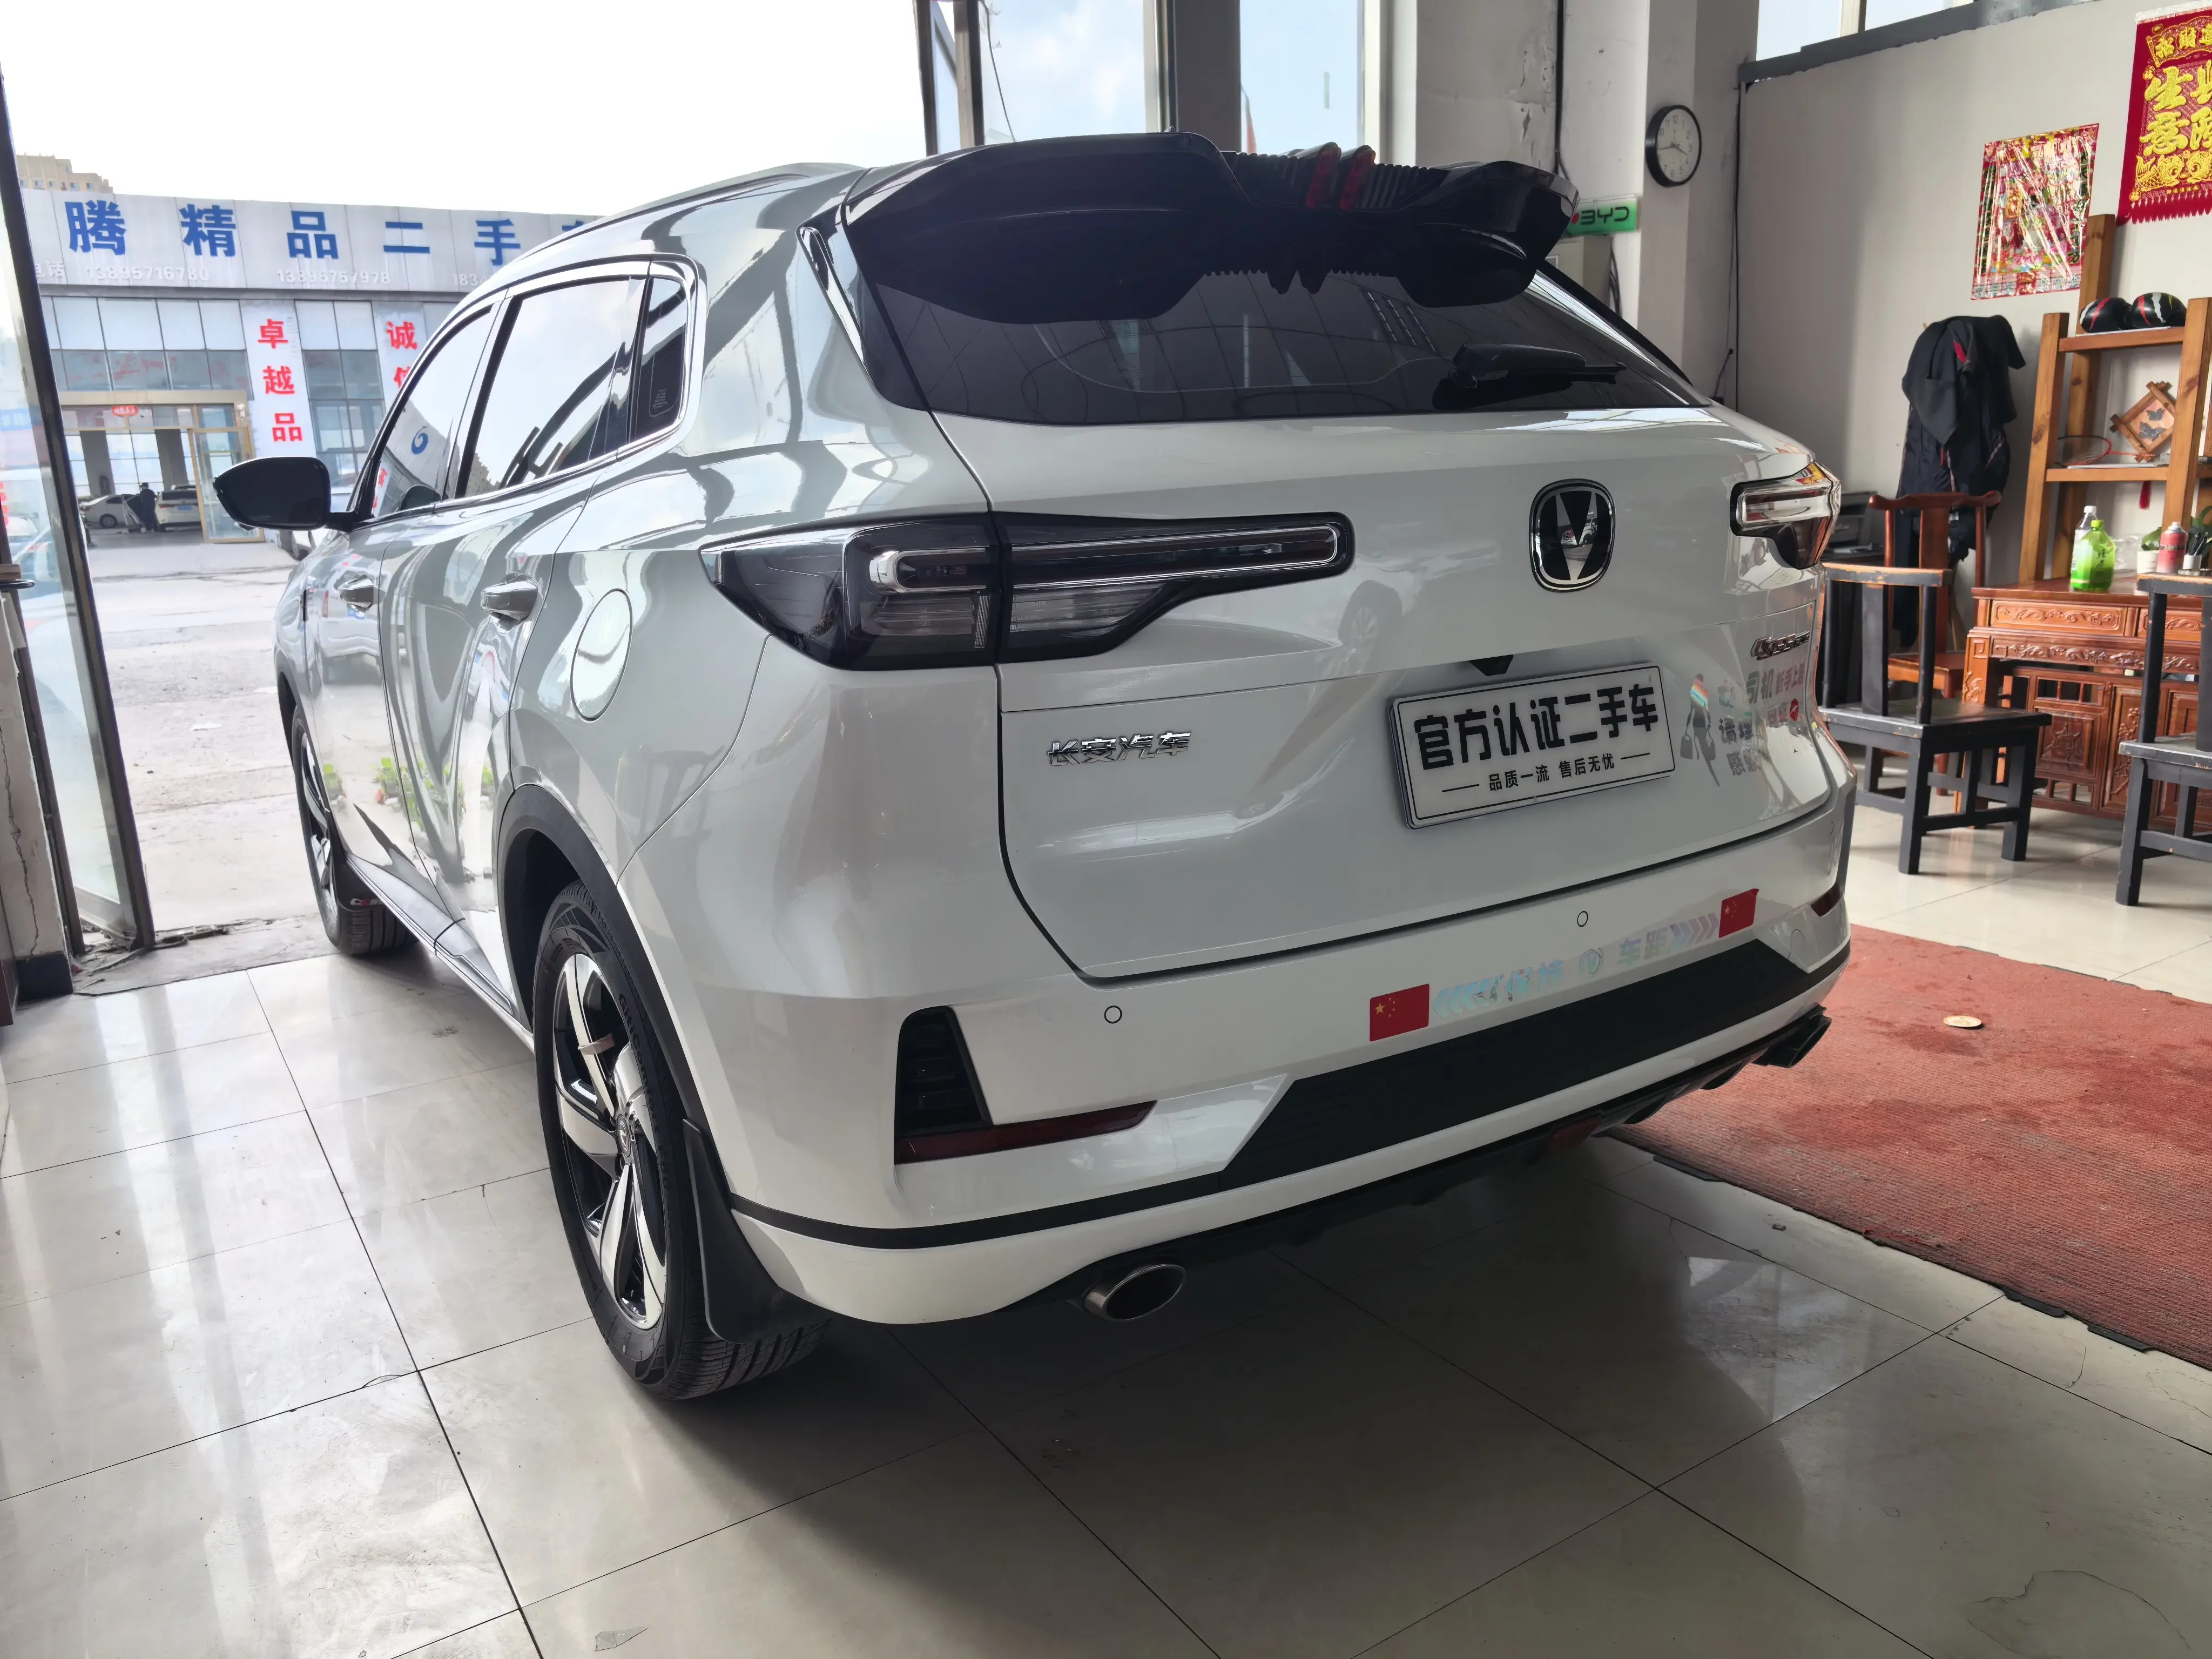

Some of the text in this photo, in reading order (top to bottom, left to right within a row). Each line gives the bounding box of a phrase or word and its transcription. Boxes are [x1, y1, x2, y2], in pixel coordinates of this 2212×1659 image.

[1580, 206, 1630, 225] BYD
[1414, 684, 1658, 770] 官方认证二手车
[1047, 731, 1192, 767] 长安汽车
[1488, 753, 1615, 792] 品质一流 售后无忧
